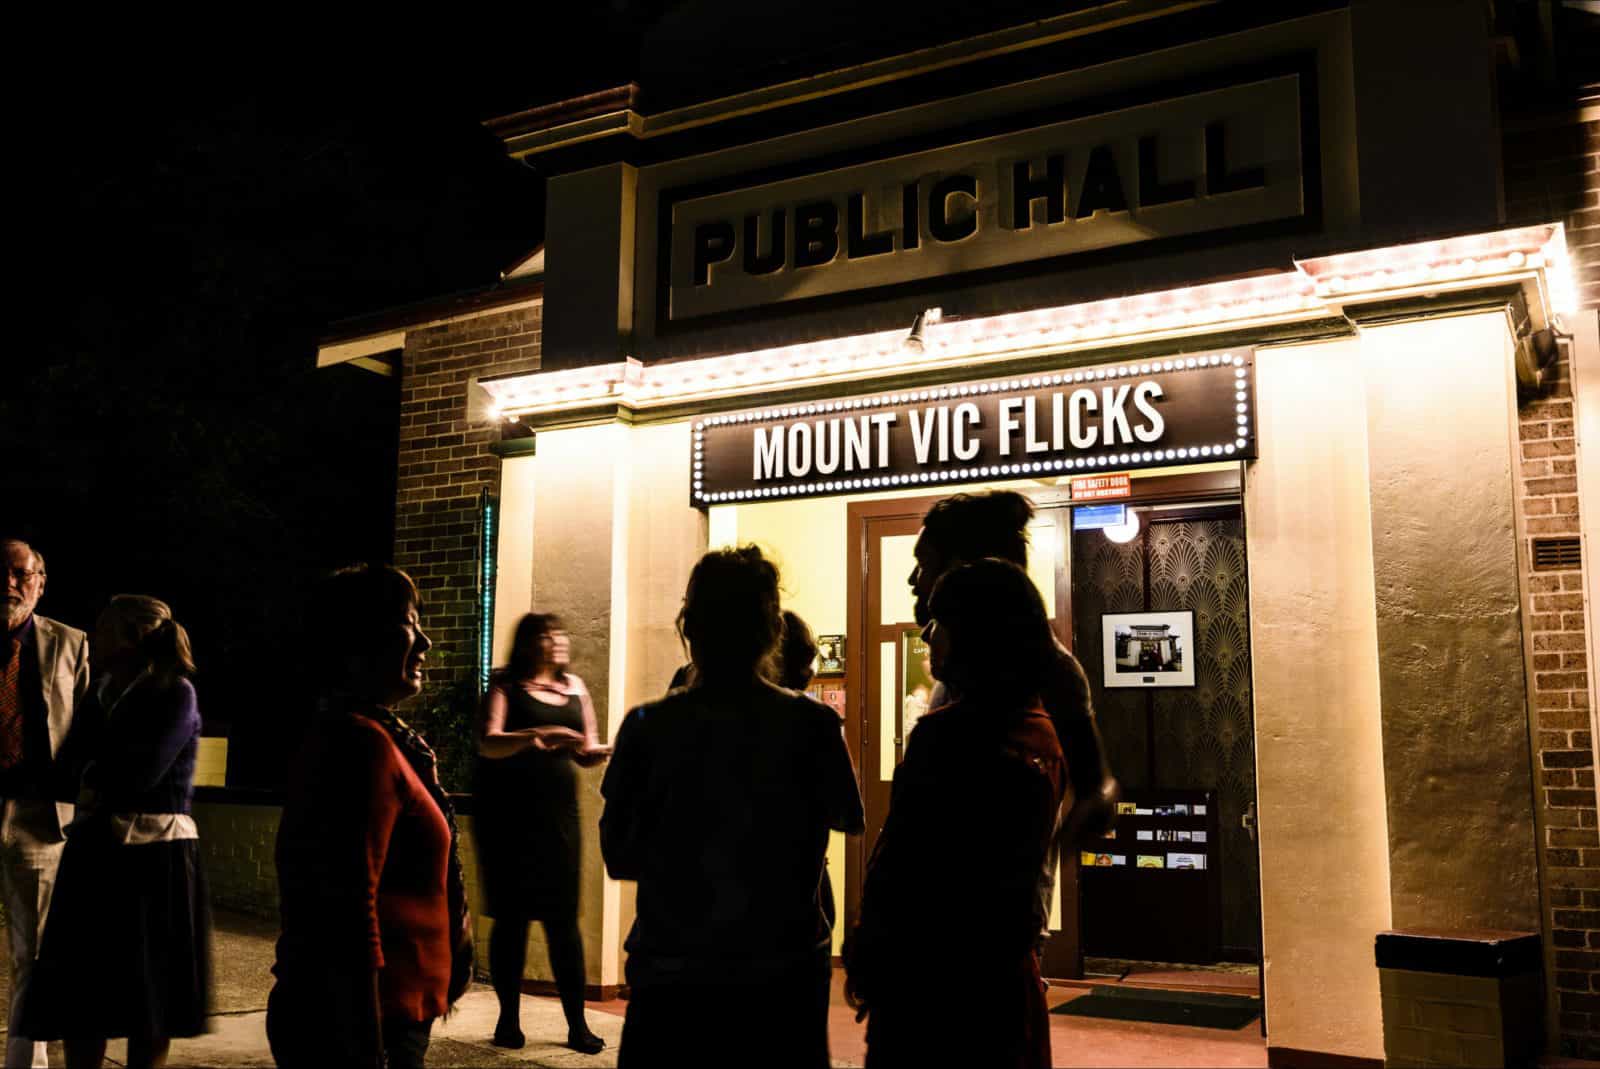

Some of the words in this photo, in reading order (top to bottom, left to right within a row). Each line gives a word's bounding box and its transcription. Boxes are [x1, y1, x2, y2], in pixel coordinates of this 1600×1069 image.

[693, 174, 980, 286] PUBLIC
[1011, 121, 1266, 231] HALL
[752, 411, 897, 481] MOUNT
[907, 402, 981, 465] VIC
[998, 380, 1166, 457] FLICKS
